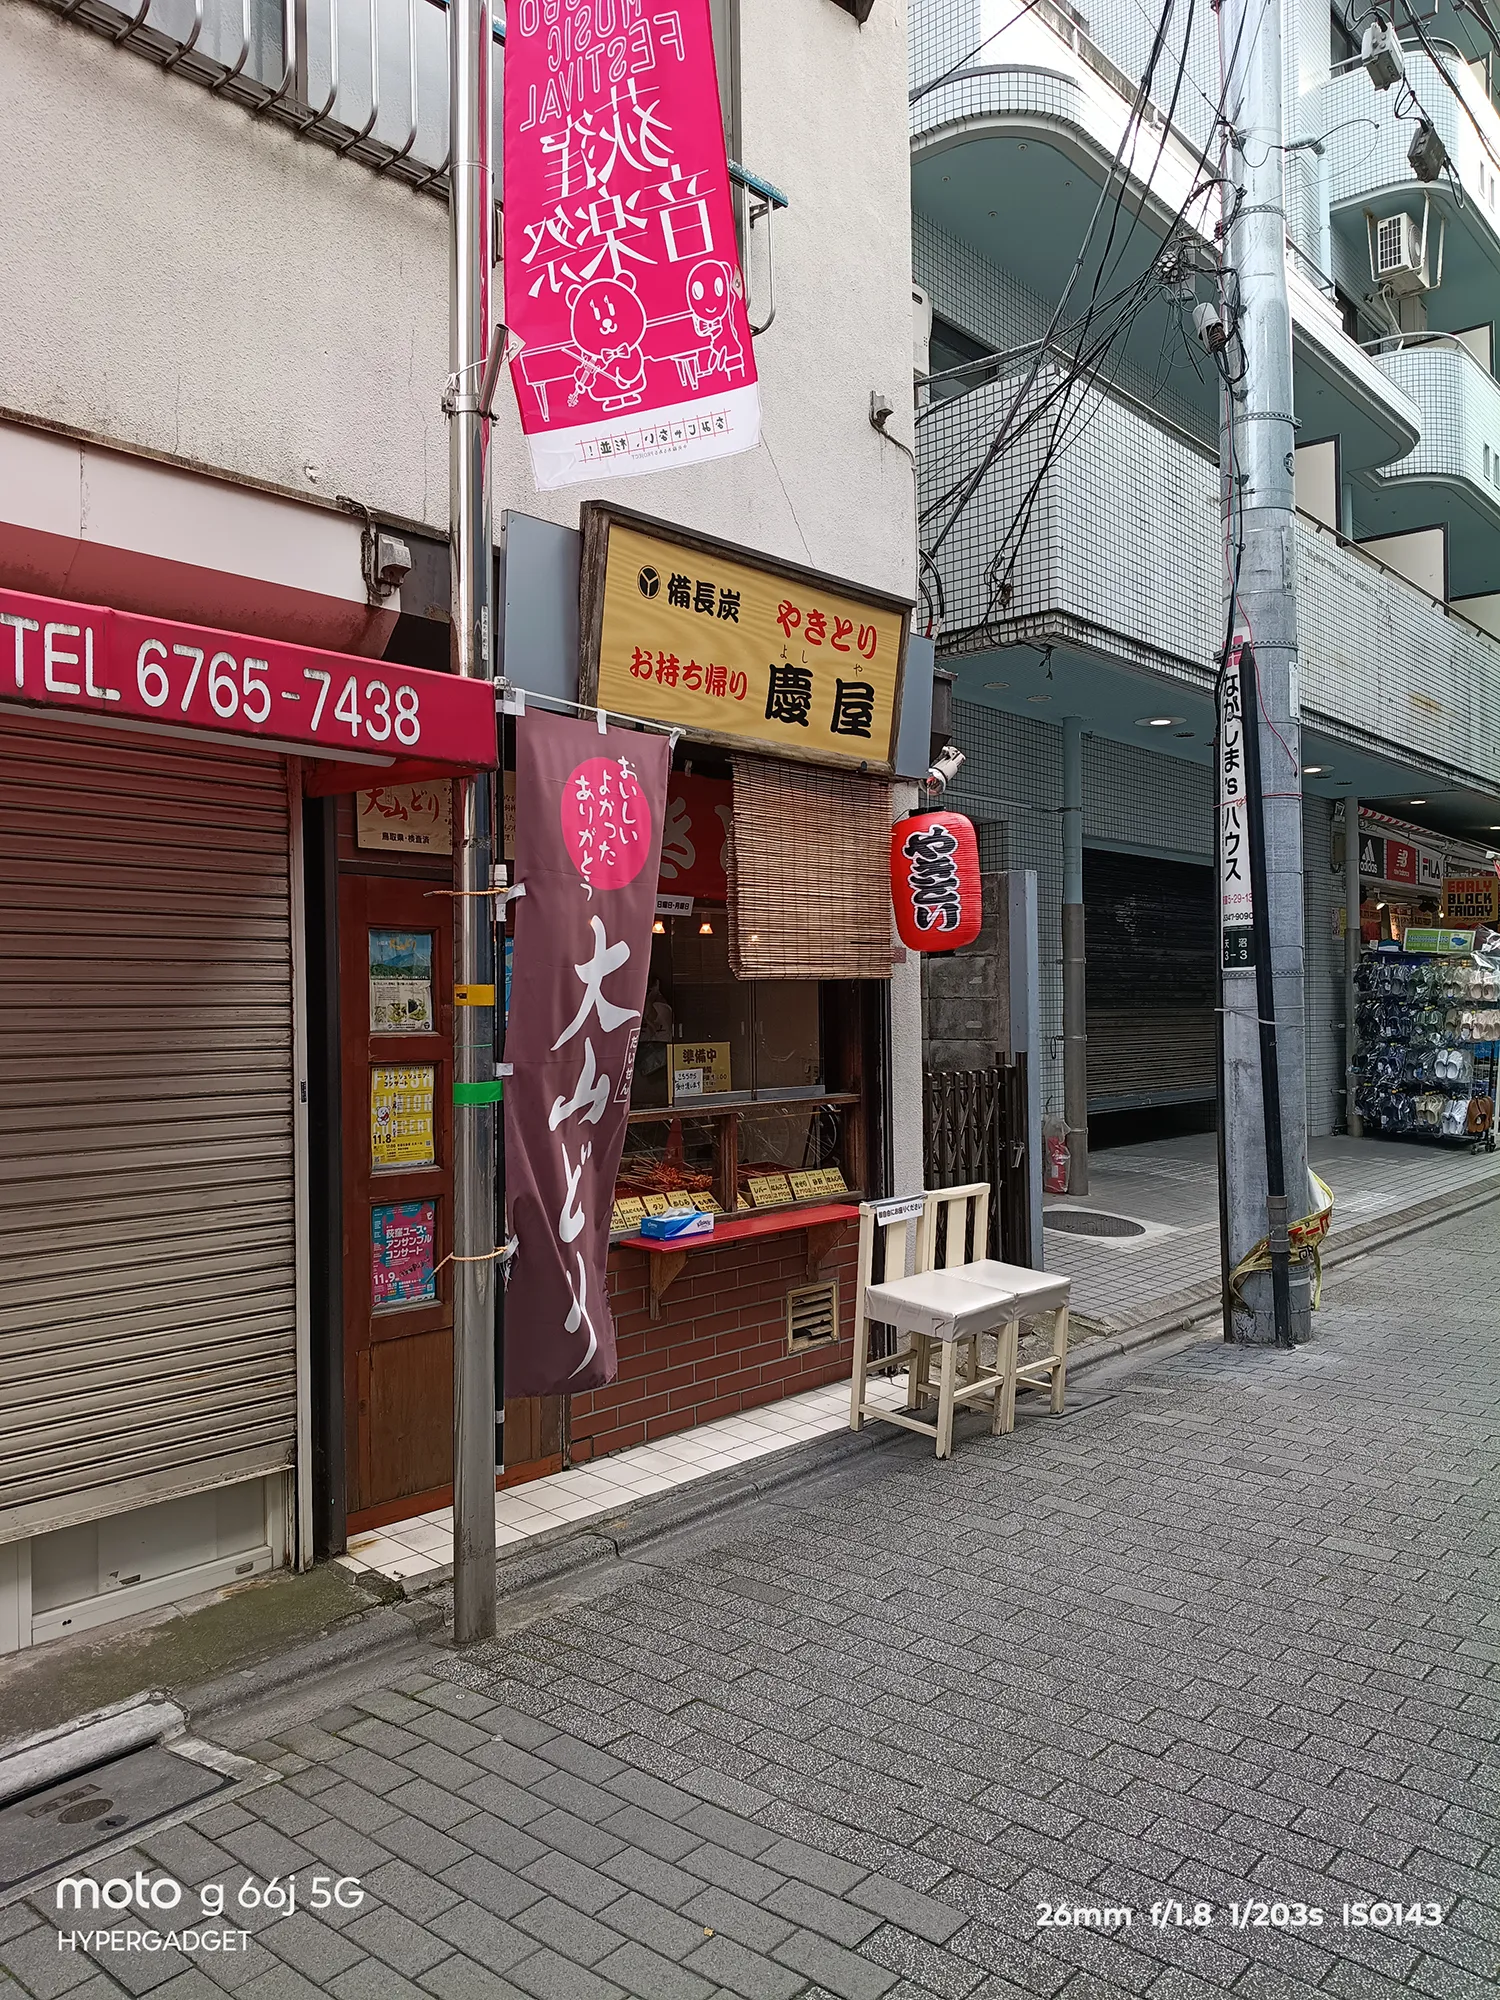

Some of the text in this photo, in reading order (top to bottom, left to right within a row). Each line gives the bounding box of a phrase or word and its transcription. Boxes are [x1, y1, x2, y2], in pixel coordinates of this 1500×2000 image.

[667, 572, 741, 624] 備長炭
[776, 600, 878, 661] やきとり
[0, 612, 421, 746] TEL 6765-7438
[629, 646, 748, 701] お持ち帰り
[617, 756, 638, 844] おいしい
[599, 769, 616, 866] よかった
[575, 775, 598, 901] ありがとう
[1360, 861, 1377, 874] adidas
[1422, 857, 1436, 880] FILA
[902, 824, 961, 932] やきとり
[1447, 880, 1493, 893] EARLY
[1447, 893, 1493, 904] BLACK
[1447, 905, 1493, 917] FRIDAY
[682, 1048, 717, 1065] 準備中
[372, 1134, 392, 1145] 11.8
[549, 915, 642, 1380] 大山どり
[753, 1186, 768, 1194] レバー
[652, 1203, 664, 1211] タン
[386, 1234, 432, 1249] アンサンブル
[385, 1247, 423, 1259] コンサート
[373, 1272, 396, 1285] 11.9
